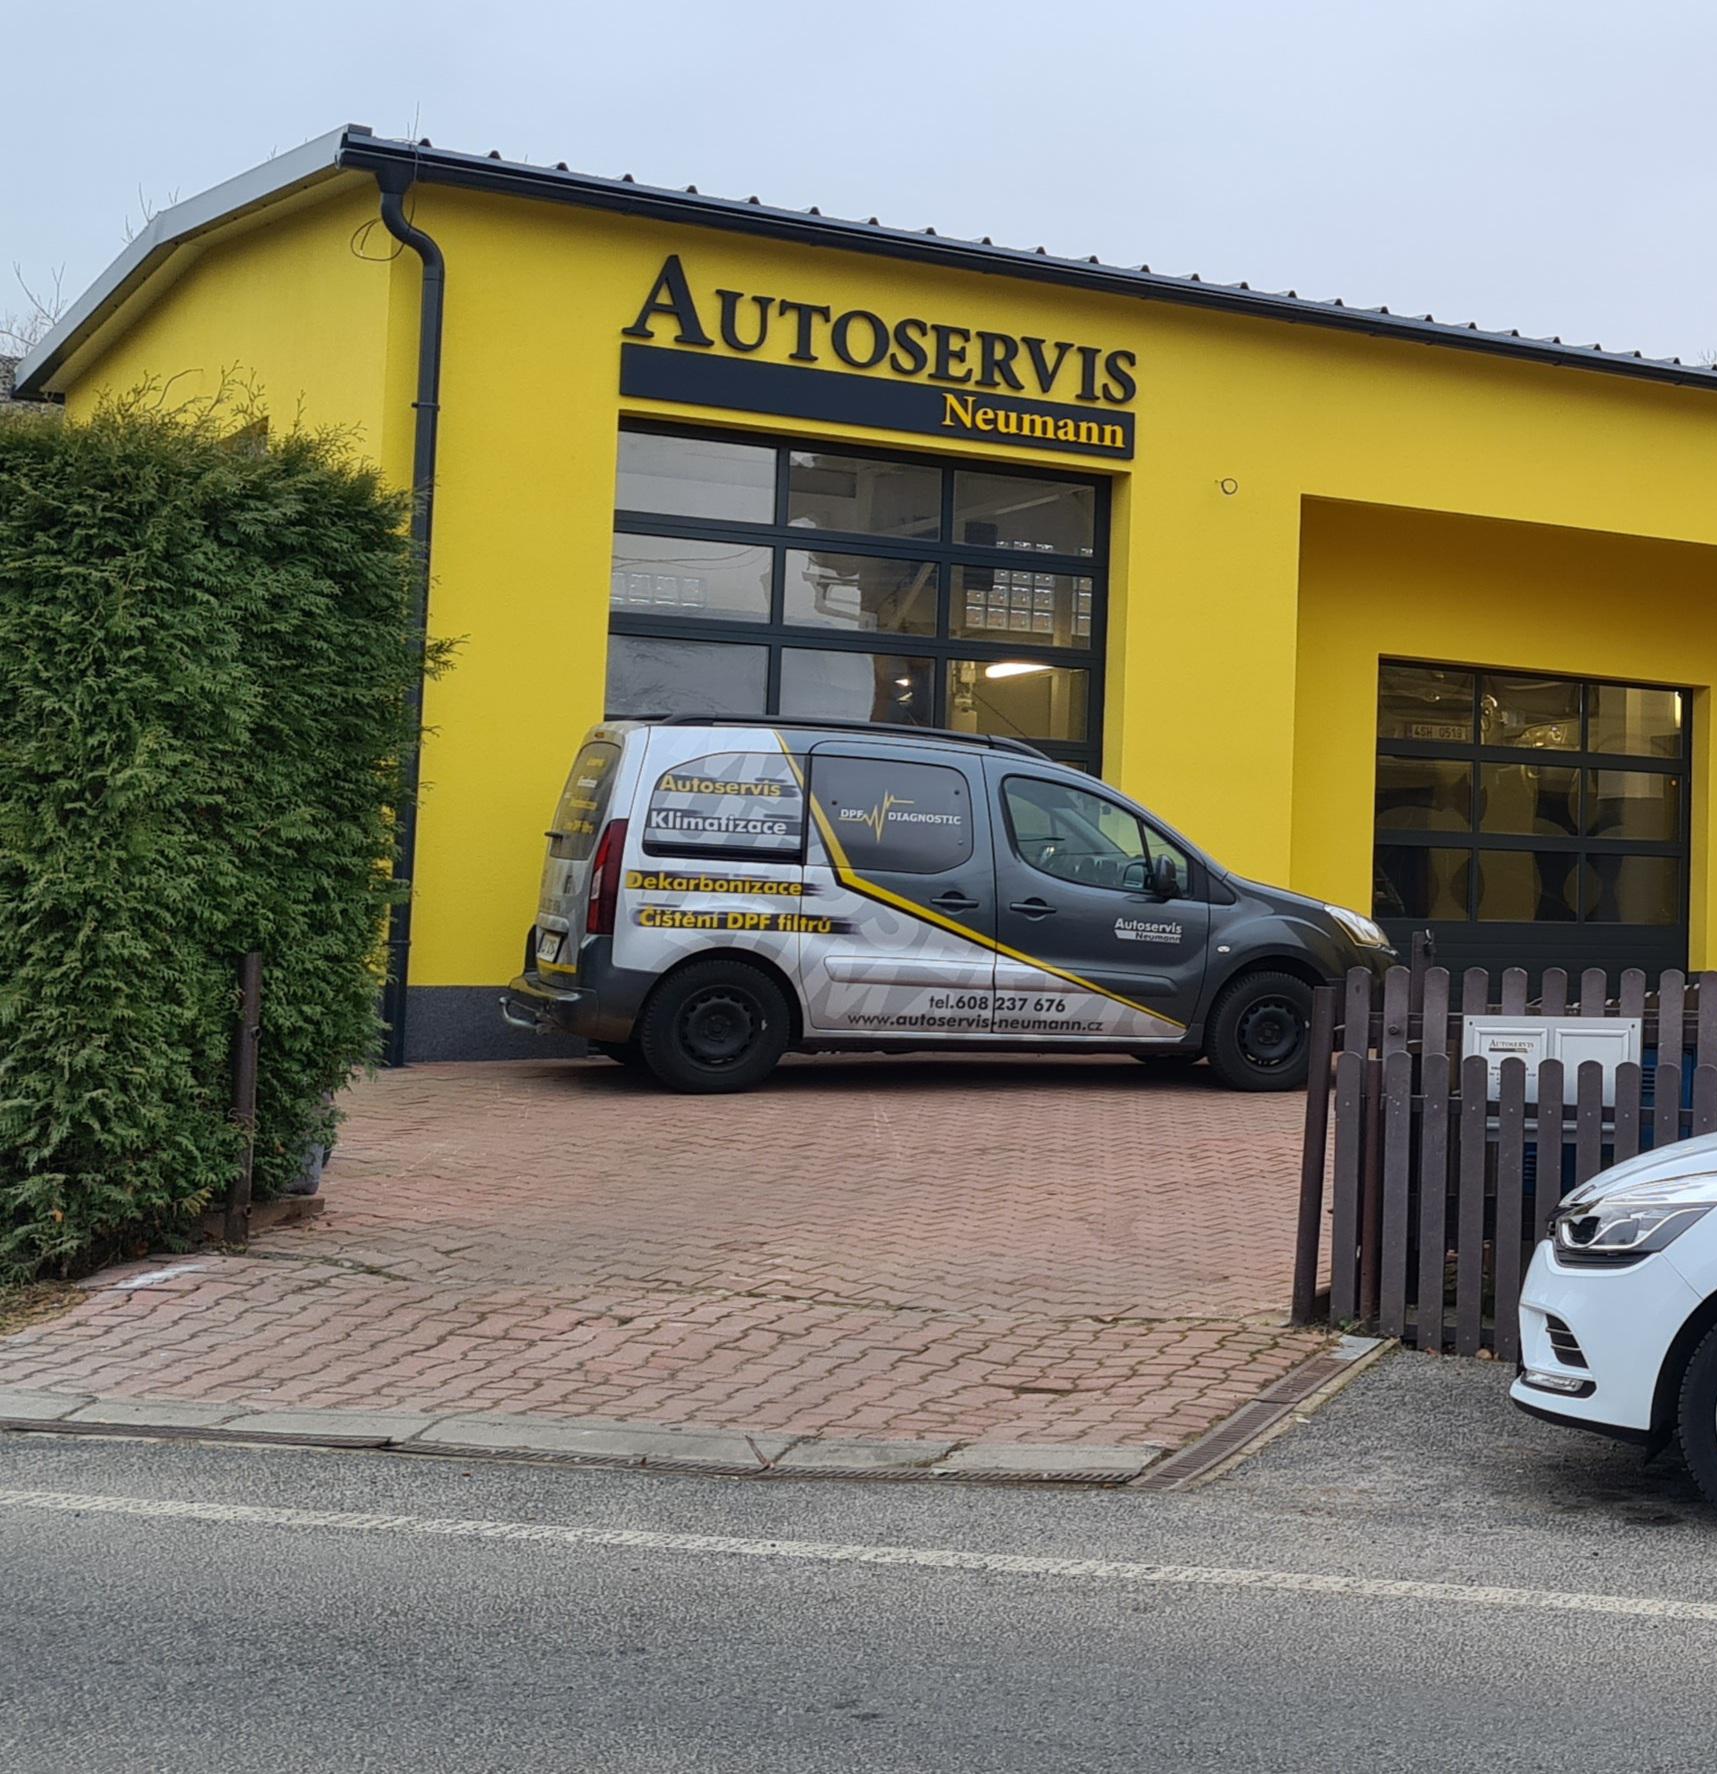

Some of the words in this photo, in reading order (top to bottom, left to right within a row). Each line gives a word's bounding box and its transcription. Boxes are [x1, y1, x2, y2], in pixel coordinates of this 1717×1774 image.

[622, 254, 1138, 404] AUTOSERVIS
[942, 392, 1125, 448] Neumann
[659, 775, 781, 797] Autoservis
[650, 810, 787, 836] Klimatizace
[841, 808, 863, 818] DPF
[888, 811, 962, 825] DIAGNOSTIC
[626, 870, 803, 896] Dekarbonizace
[639, 906, 718, 929] Čištění
[727, 912, 770, 930] DPF
[1114, 918, 1182, 933] Autoservis
[1136, 932, 1180, 943] Neumann
[996, 996, 1028, 1011] 237
[1034, 998, 1066, 1012] 676
[847, 1012, 1103, 1033] www.autoservis-neumann.cz
